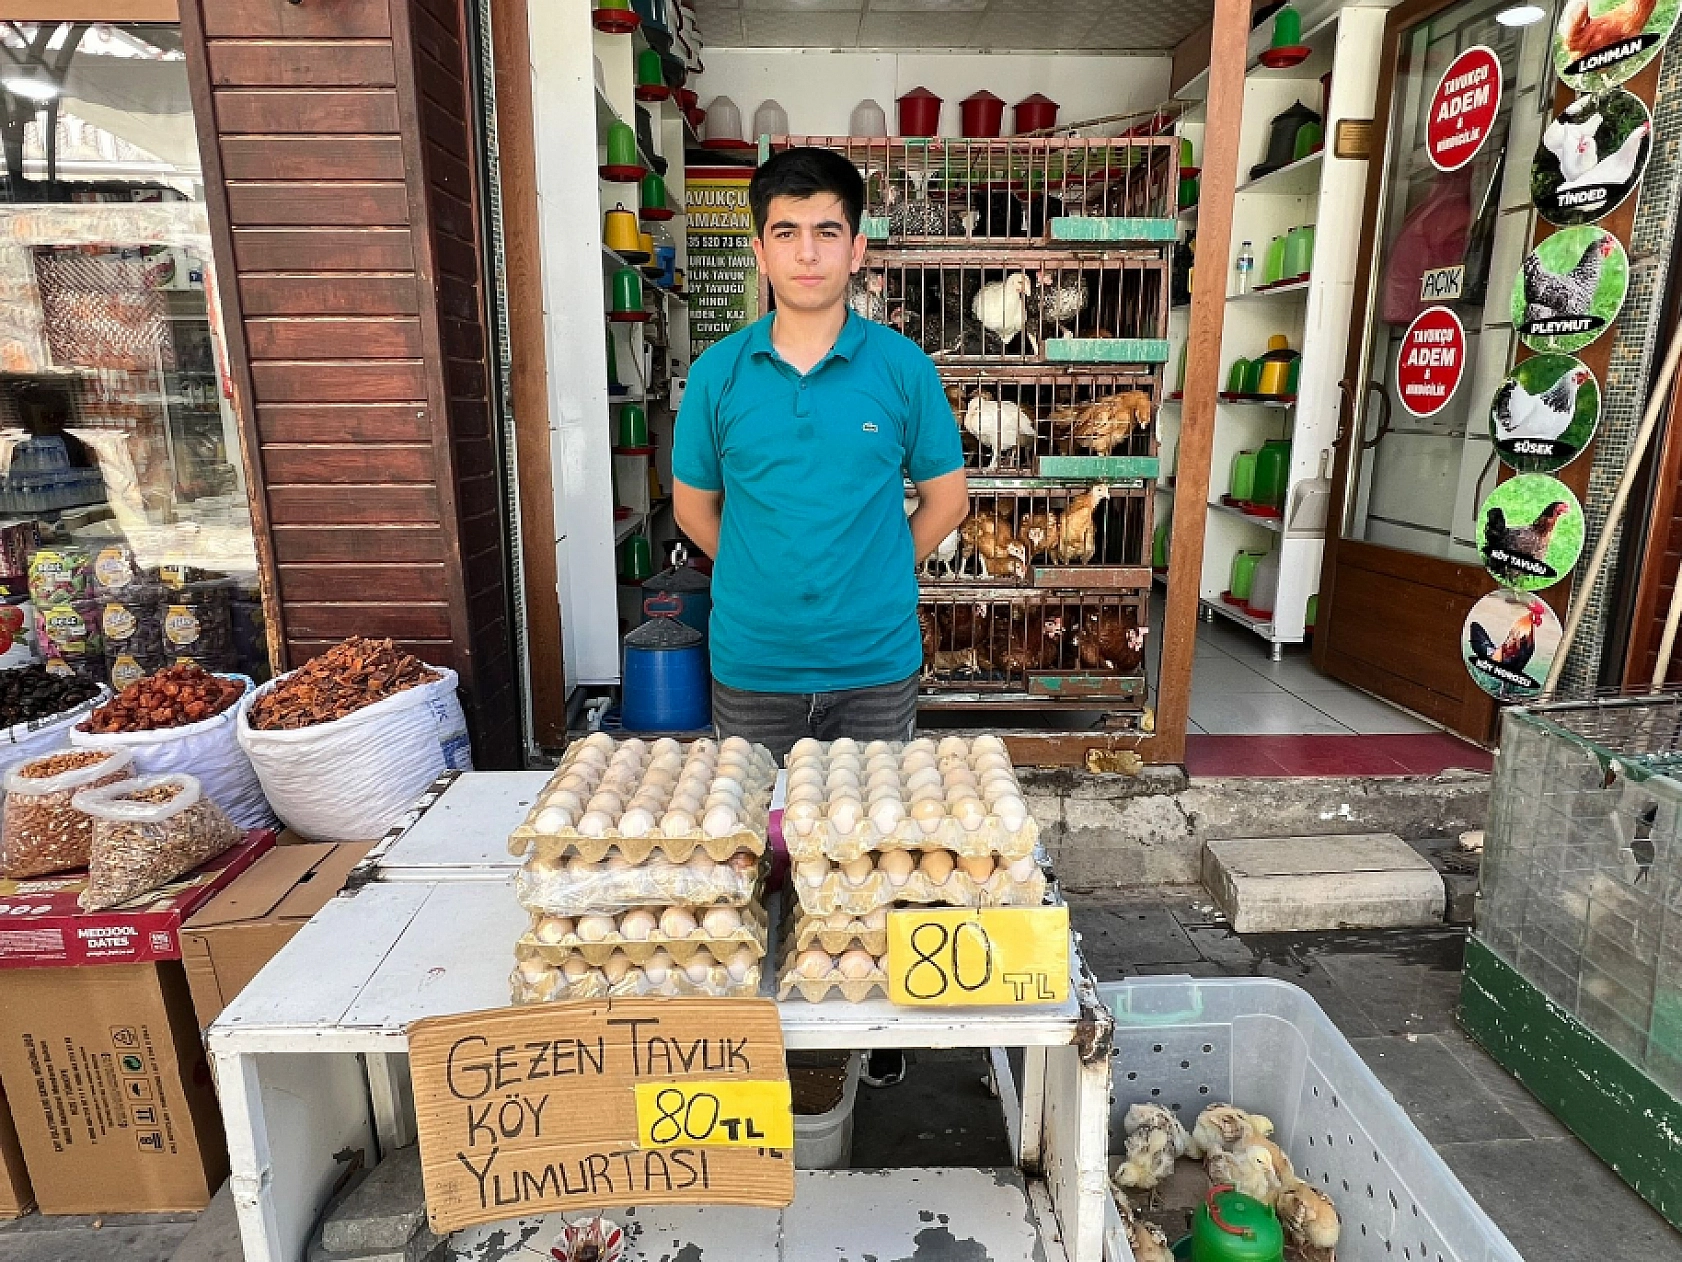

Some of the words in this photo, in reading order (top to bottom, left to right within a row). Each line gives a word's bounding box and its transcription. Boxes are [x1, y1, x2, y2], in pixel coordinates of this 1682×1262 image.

[1579, 38, 1642, 72] LOHMAN
[1437, 84, 1490, 123] ADEM
[712, 269, 744, 280] TAVUK
[1423, 268, 1461, 297] AÇIK
[1407, 347, 1456, 367] ADEM
[87, 937, 130, 949] DATES
[905, 922, 992, 999] 80
[1003, 973, 1055, 1001] TL
[447, 1036, 605, 1100] GEZEN
[607, 1018, 751, 1076] TAVUK
[467, 1093, 549, 1146] KÖY
[651, 1088, 719, 1144] 80
[719, 1118, 764, 1141] TL
[457, 1147, 709, 1209] YUMURTASI
